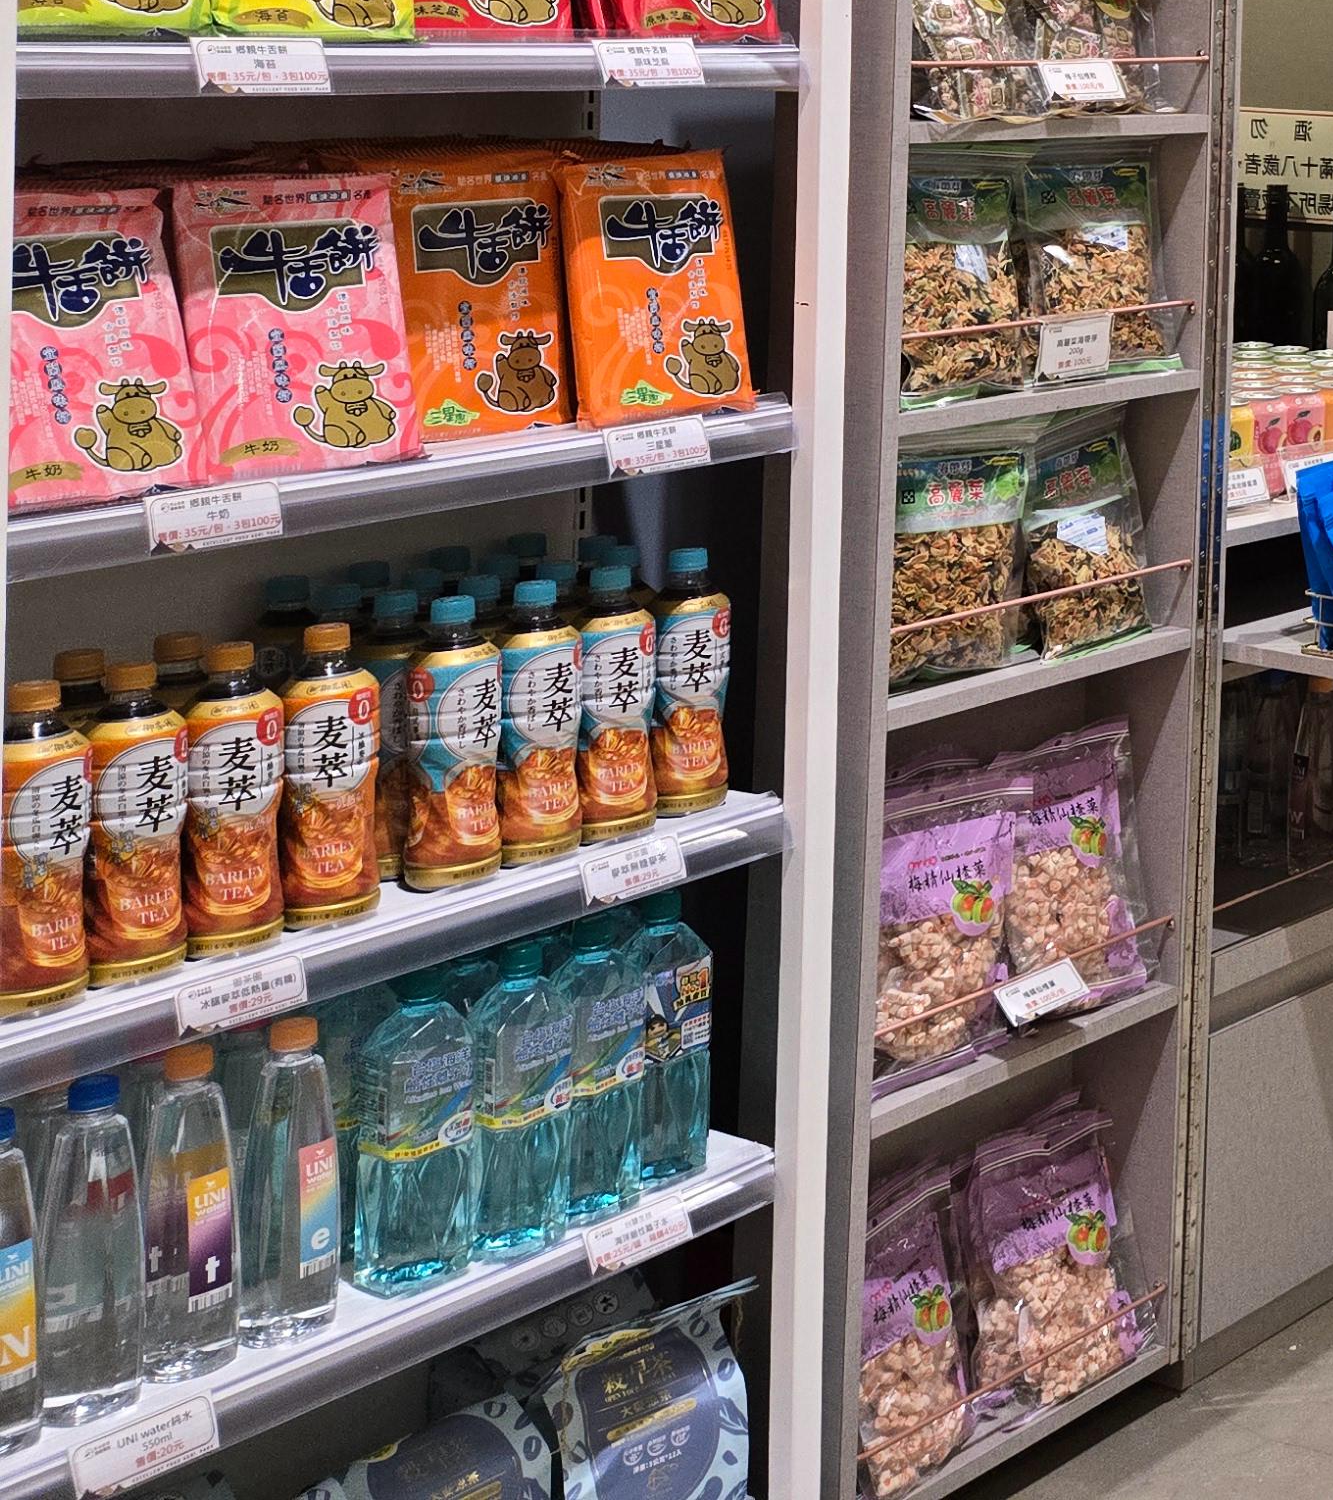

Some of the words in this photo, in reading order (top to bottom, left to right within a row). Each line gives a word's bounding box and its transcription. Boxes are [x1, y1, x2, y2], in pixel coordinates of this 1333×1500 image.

[646, 13, 695, 28] 原味芝麻
[235, 45, 288, 55] 鄉親牛舌餅
[253, 59, 278, 69] 海苔
[418, 203, 552, 279] 牛舌餅
[606, 200, 722, 267] 牛舌餅
[219, 225, 380, 305] 牛舌餅
[244, 440, 280, 456] 牛奶
[25, 464, 63, 481] 牛奶
[189, 493, 242, 508] 鄉親牛舌餅
[926, 478, 986, 504] 高麗菜
[206, 509, 230, 521] 牛奶
[682, 629, 712, 692] 麦萃
[608, 646, 639, 713] 麦萃
[543, 662, 573, 732] 麦萃
[473, 678, 498, 748] 麦萃
[312, 716, 348, 788] 麦萃
[671, 738, 716, 756] BARLEY
[683, 753, 710, 768] TEA
[219, 737, 256, 812] 麦萃
[136, 755, 174, 832] 麦萃
[609, 779, 637, 793] TEA
[459, 802, 496, 819] BARLE
[542, 796, 570, 811] TEA
[50, 775, 83, 855] 麦萃
[471, 817, 495, 832] TEA
[205, 864, 264, 888] BARLEY
[315, 858, 345, 874] TEA
[120, 886, 175, 912] BARLEY
[220, 884, 254, 902] TEA
[138, 907, 170, 926] TEA
[48, 933, 78, 951] TEA
[305, 1156, 334, 1179] UNI
[194, 1187, 227, 1209] UNI
[311, 1227, 330, 1250] e
[205, 1256, 220, 1284] t
[117, 1432, 137, 1450] UNI
[142, 1431, 173, 1452] 550ml
